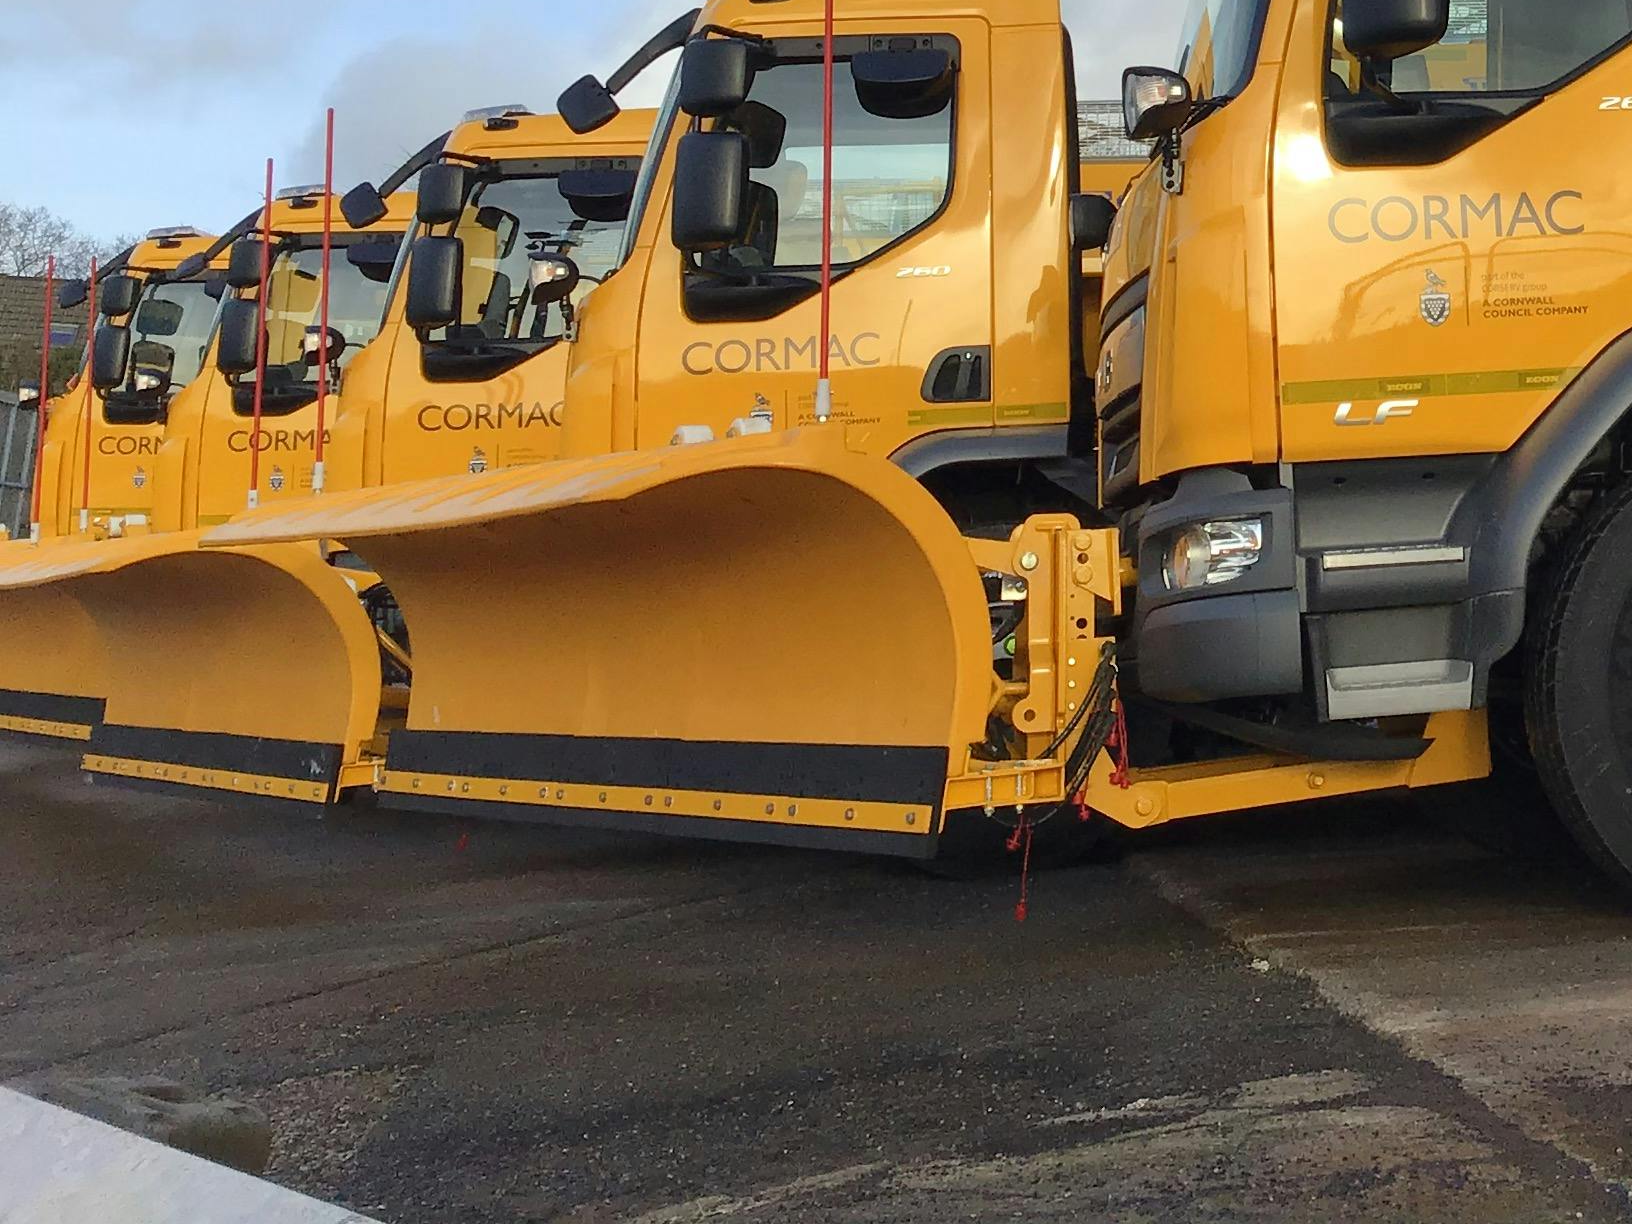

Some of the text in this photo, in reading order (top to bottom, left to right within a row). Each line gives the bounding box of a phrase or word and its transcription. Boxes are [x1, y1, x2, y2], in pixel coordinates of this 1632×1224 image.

[1327, 189, 1585, 244] CORMAC
[896, 266, 951, 277] 260
[1482, 296, 1555, 308] A CORNWALL
[1483, 305, 1589, 319] COUNCIL COMPANY
[681, 332, 880, 376] CORMAC
[1334, 399, 1419, 426] LF
